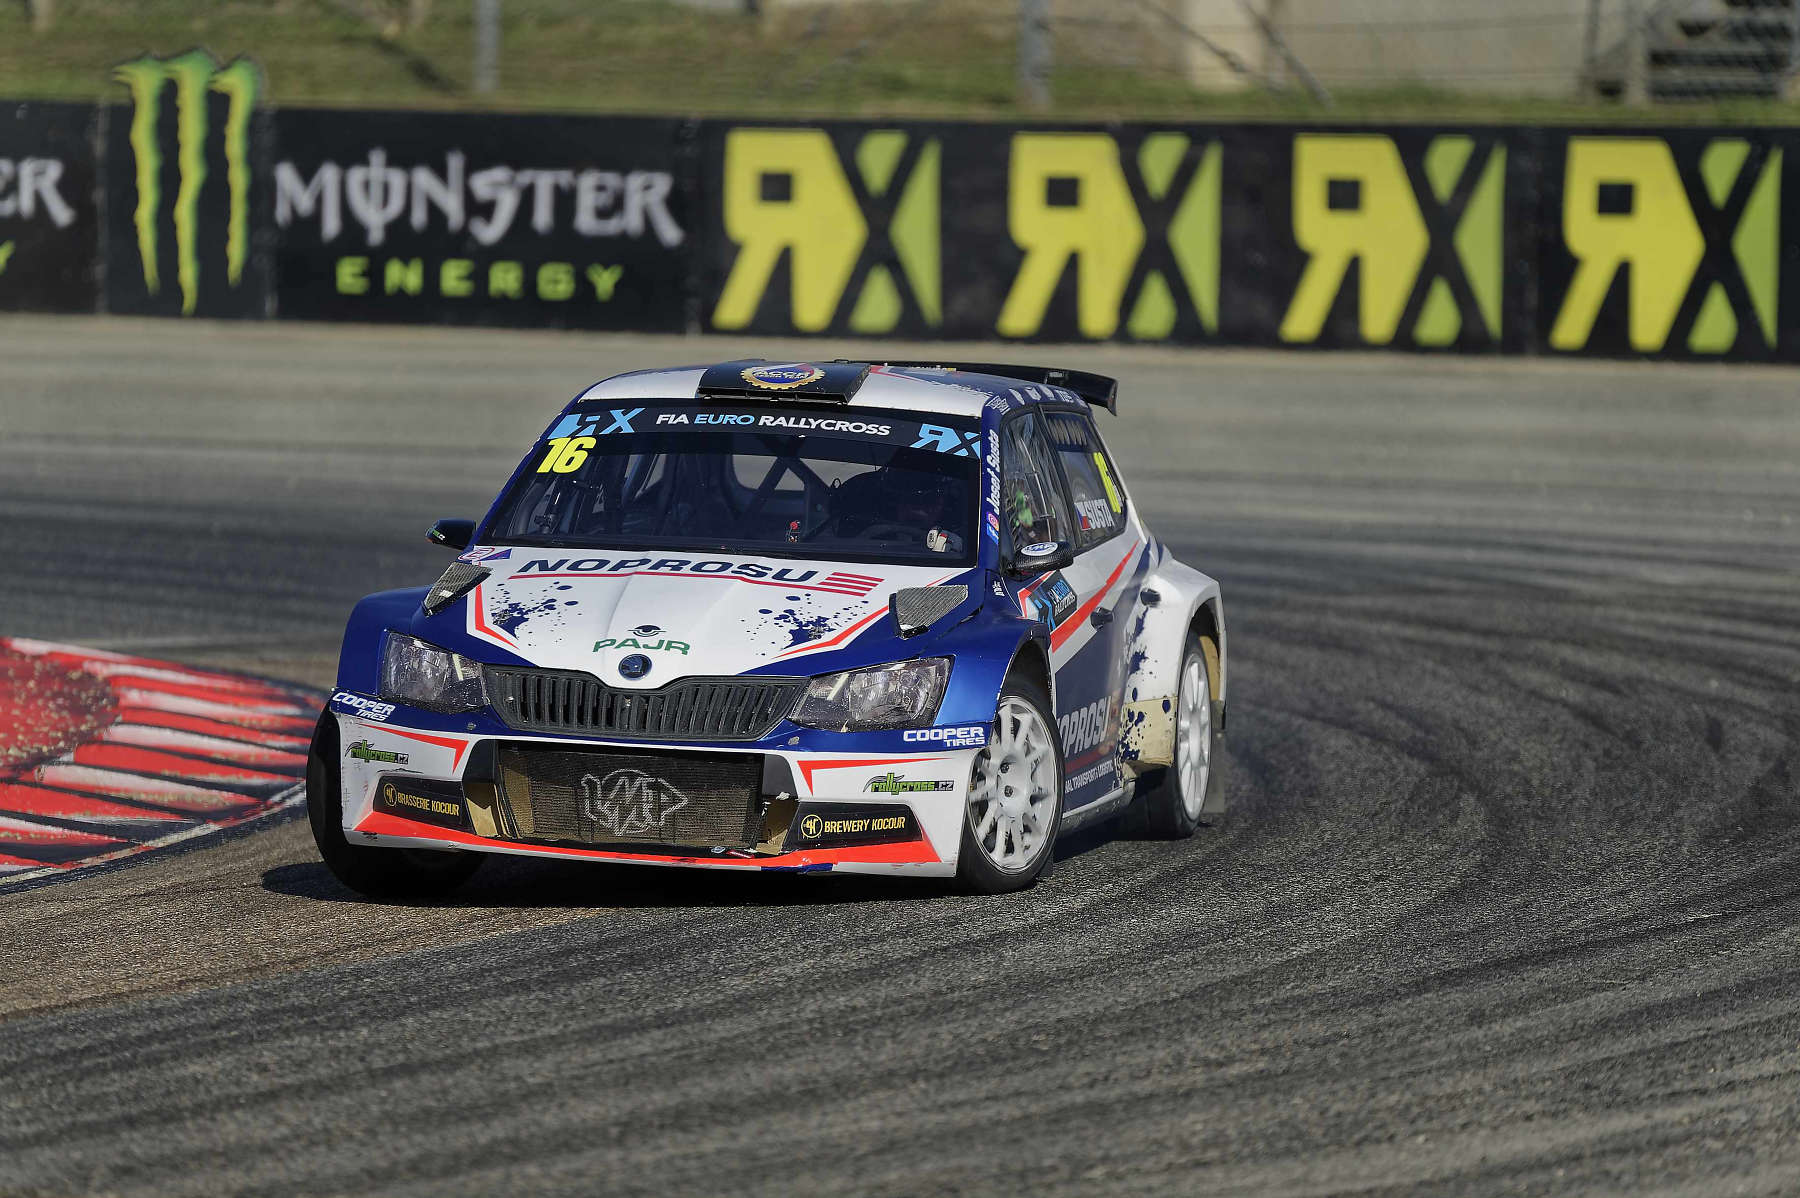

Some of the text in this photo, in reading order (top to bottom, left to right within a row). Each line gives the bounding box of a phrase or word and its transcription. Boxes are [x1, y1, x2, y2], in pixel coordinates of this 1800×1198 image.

[274, 147, 684, 247] MONSTER
[711, 129, 942, 334] RX
[996, 131, 1223, 339] RX
[1279, 133, 1508, 346] RX
[1549, 136, 1783, 353] RX
[335, 256, 623, 301] ENERGY
[656, 414, 891, 436] FIA EURO RALLYCROSS
[536, 437, 597, 474] 16
[516, 558, 819, 582] NOPROSU
[592, 637, 690, 655] PAJR
[332, 692, 396, 715] COOPER
[356, 708, 390, 722] TIRES
[903, 726, 985, 742] COOPER
[943, 737, 986, 748] TIRES
[397, 791, 460, 816] BRASSERIE KOCOUR
[824, 816, 906, 833] BREWERY KOCOUR
